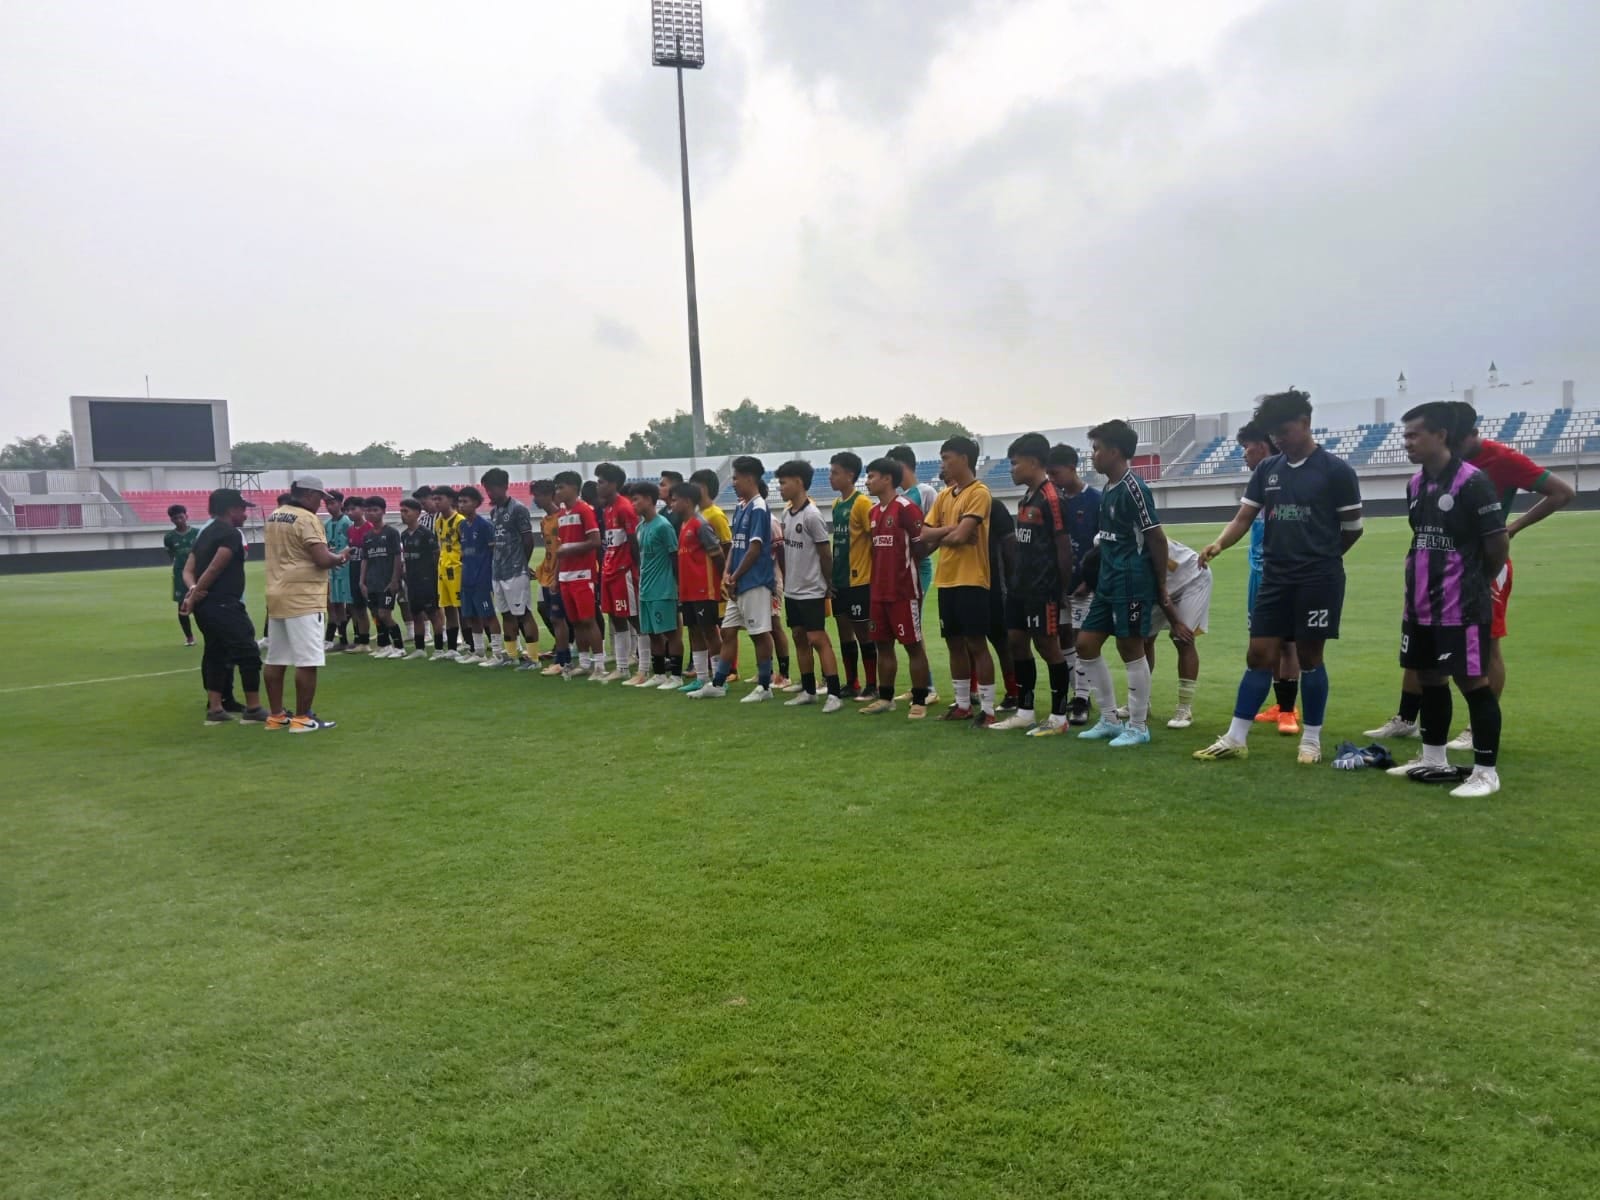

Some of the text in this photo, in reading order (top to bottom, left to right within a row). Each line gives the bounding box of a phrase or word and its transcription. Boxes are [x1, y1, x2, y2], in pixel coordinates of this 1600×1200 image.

[615, 599, 627, 612] 24
[1308, 610, 1329, 627] 22
[897, 623, 905, 637] 3
[1401, 634, 1409, 653] 9
